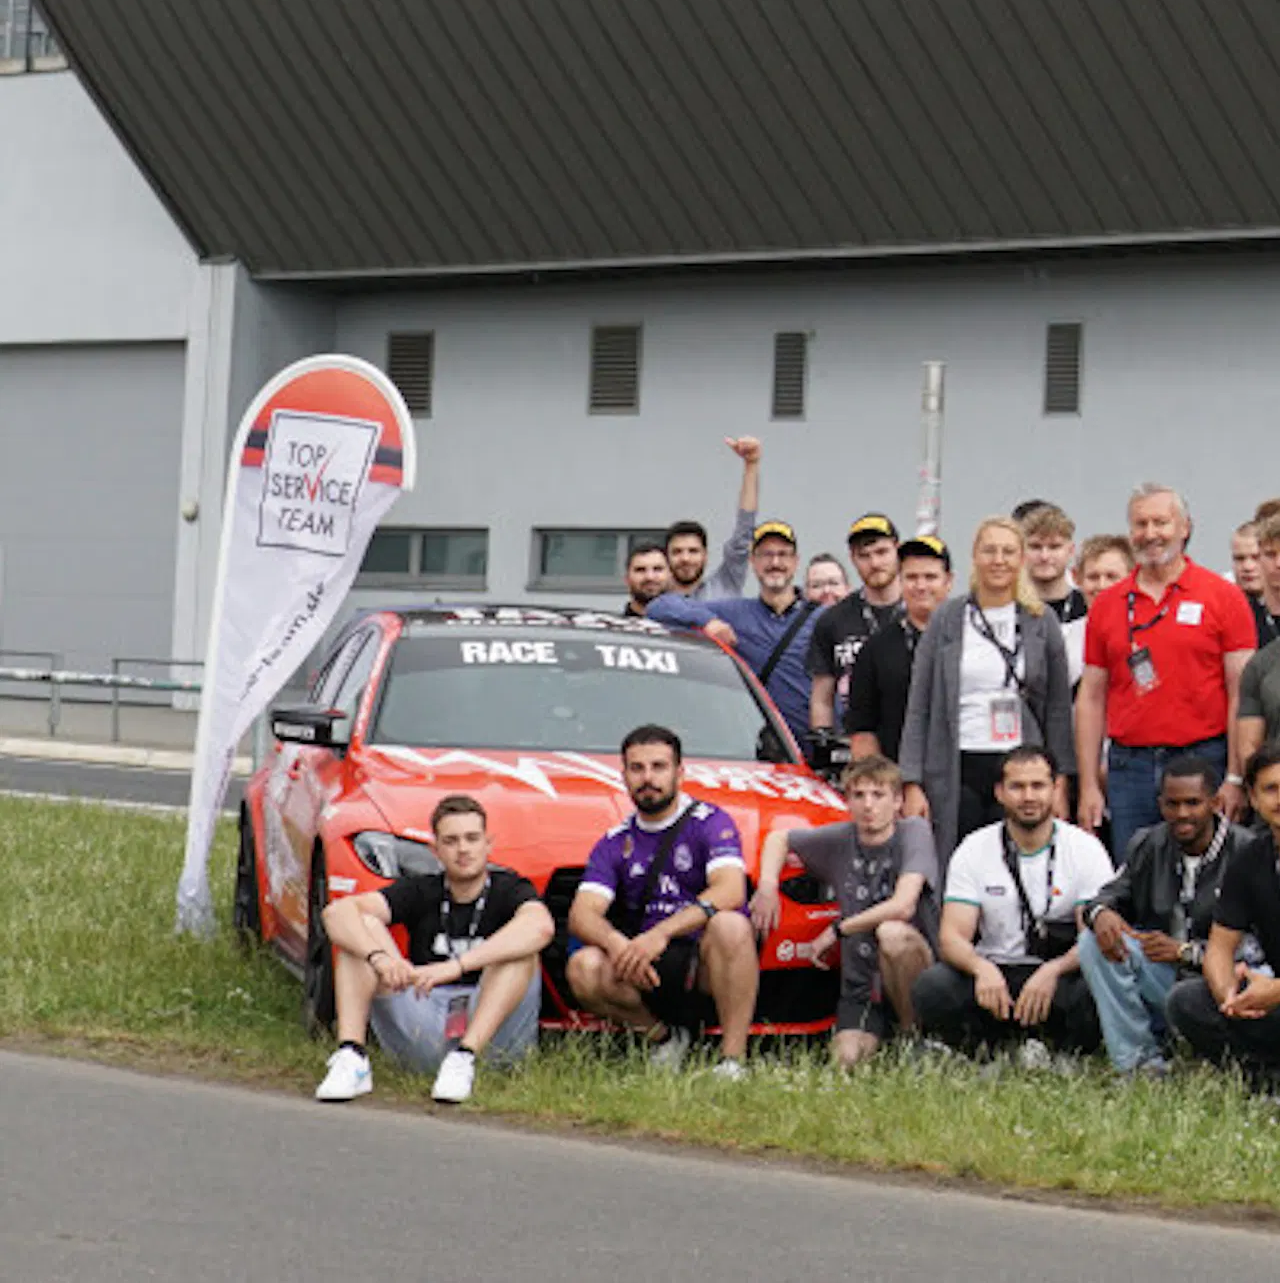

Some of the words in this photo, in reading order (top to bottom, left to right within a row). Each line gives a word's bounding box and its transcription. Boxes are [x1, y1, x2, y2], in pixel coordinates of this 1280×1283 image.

[288, 441, 327, 468] TOP
[271, 473, 353, 506] SERVICE
[277, 508, 335, 537] TEAM
[460, 641, 558, 664] RACE
[594, 644, 679, 674] TAXI
